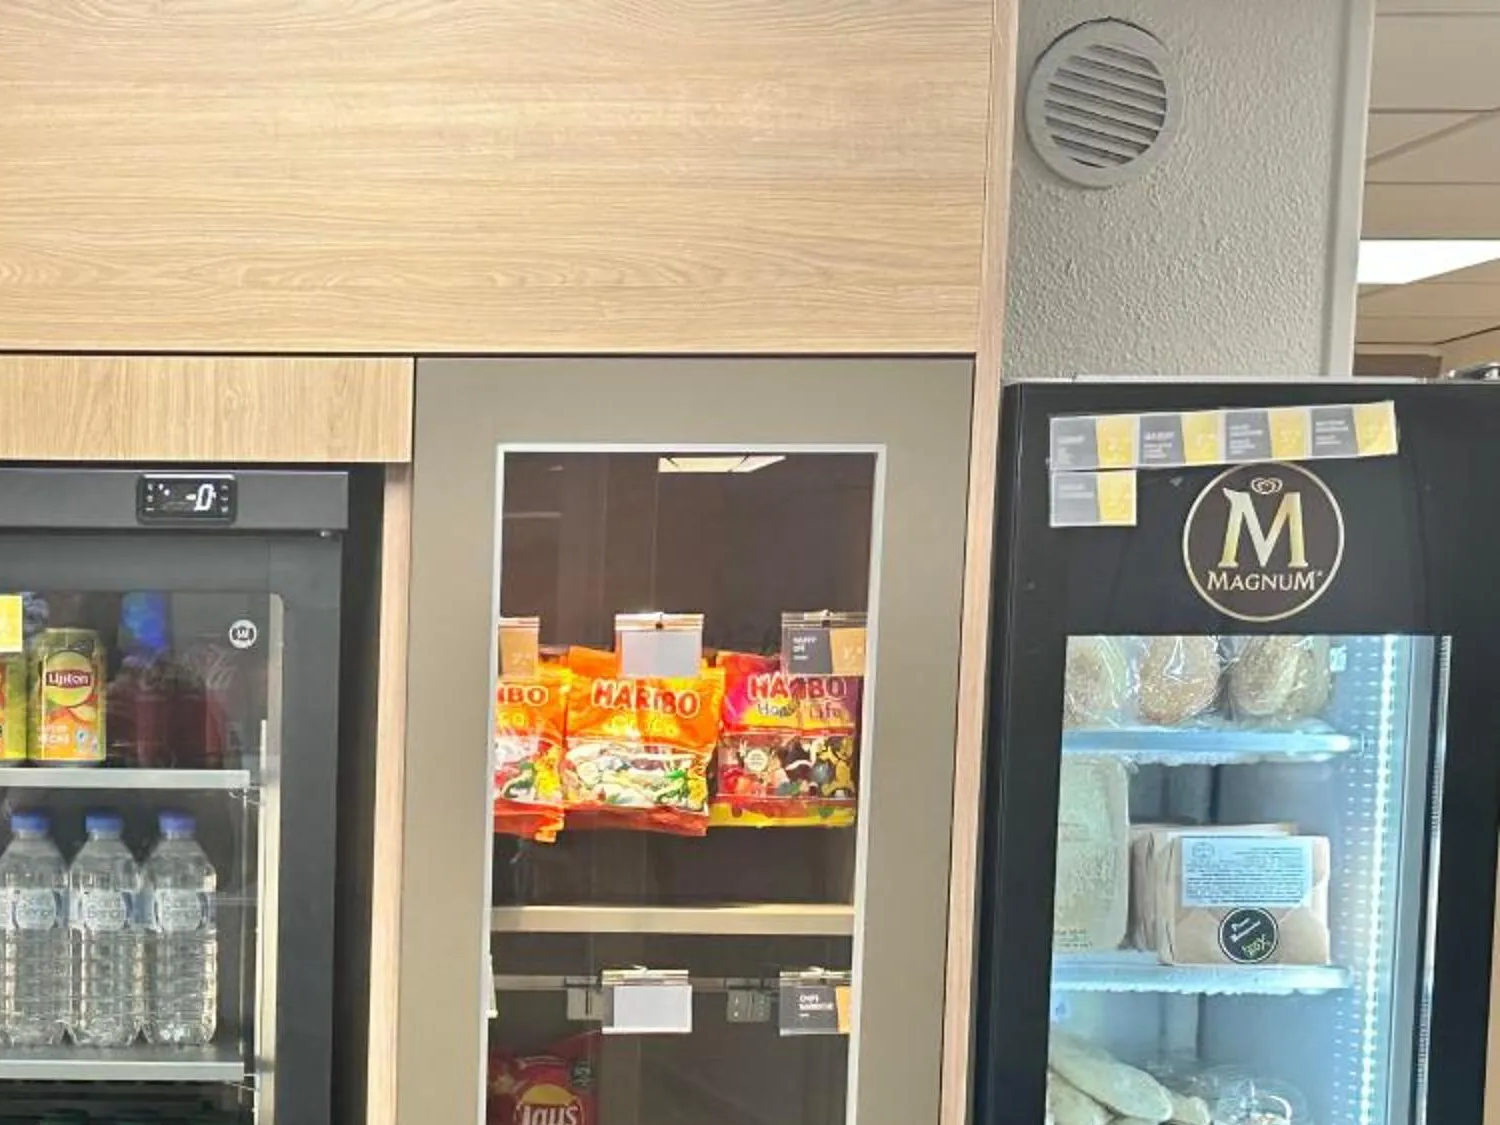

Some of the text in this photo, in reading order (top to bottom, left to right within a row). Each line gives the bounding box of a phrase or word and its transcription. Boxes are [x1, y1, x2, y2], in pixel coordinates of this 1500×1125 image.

[1206, 570, 1317, 591] MAGNUM
[47, 671, 90, 687] Lipton
[497, 685, 549, 706] IBO
[592, 679, 700, 718] HARIBO
